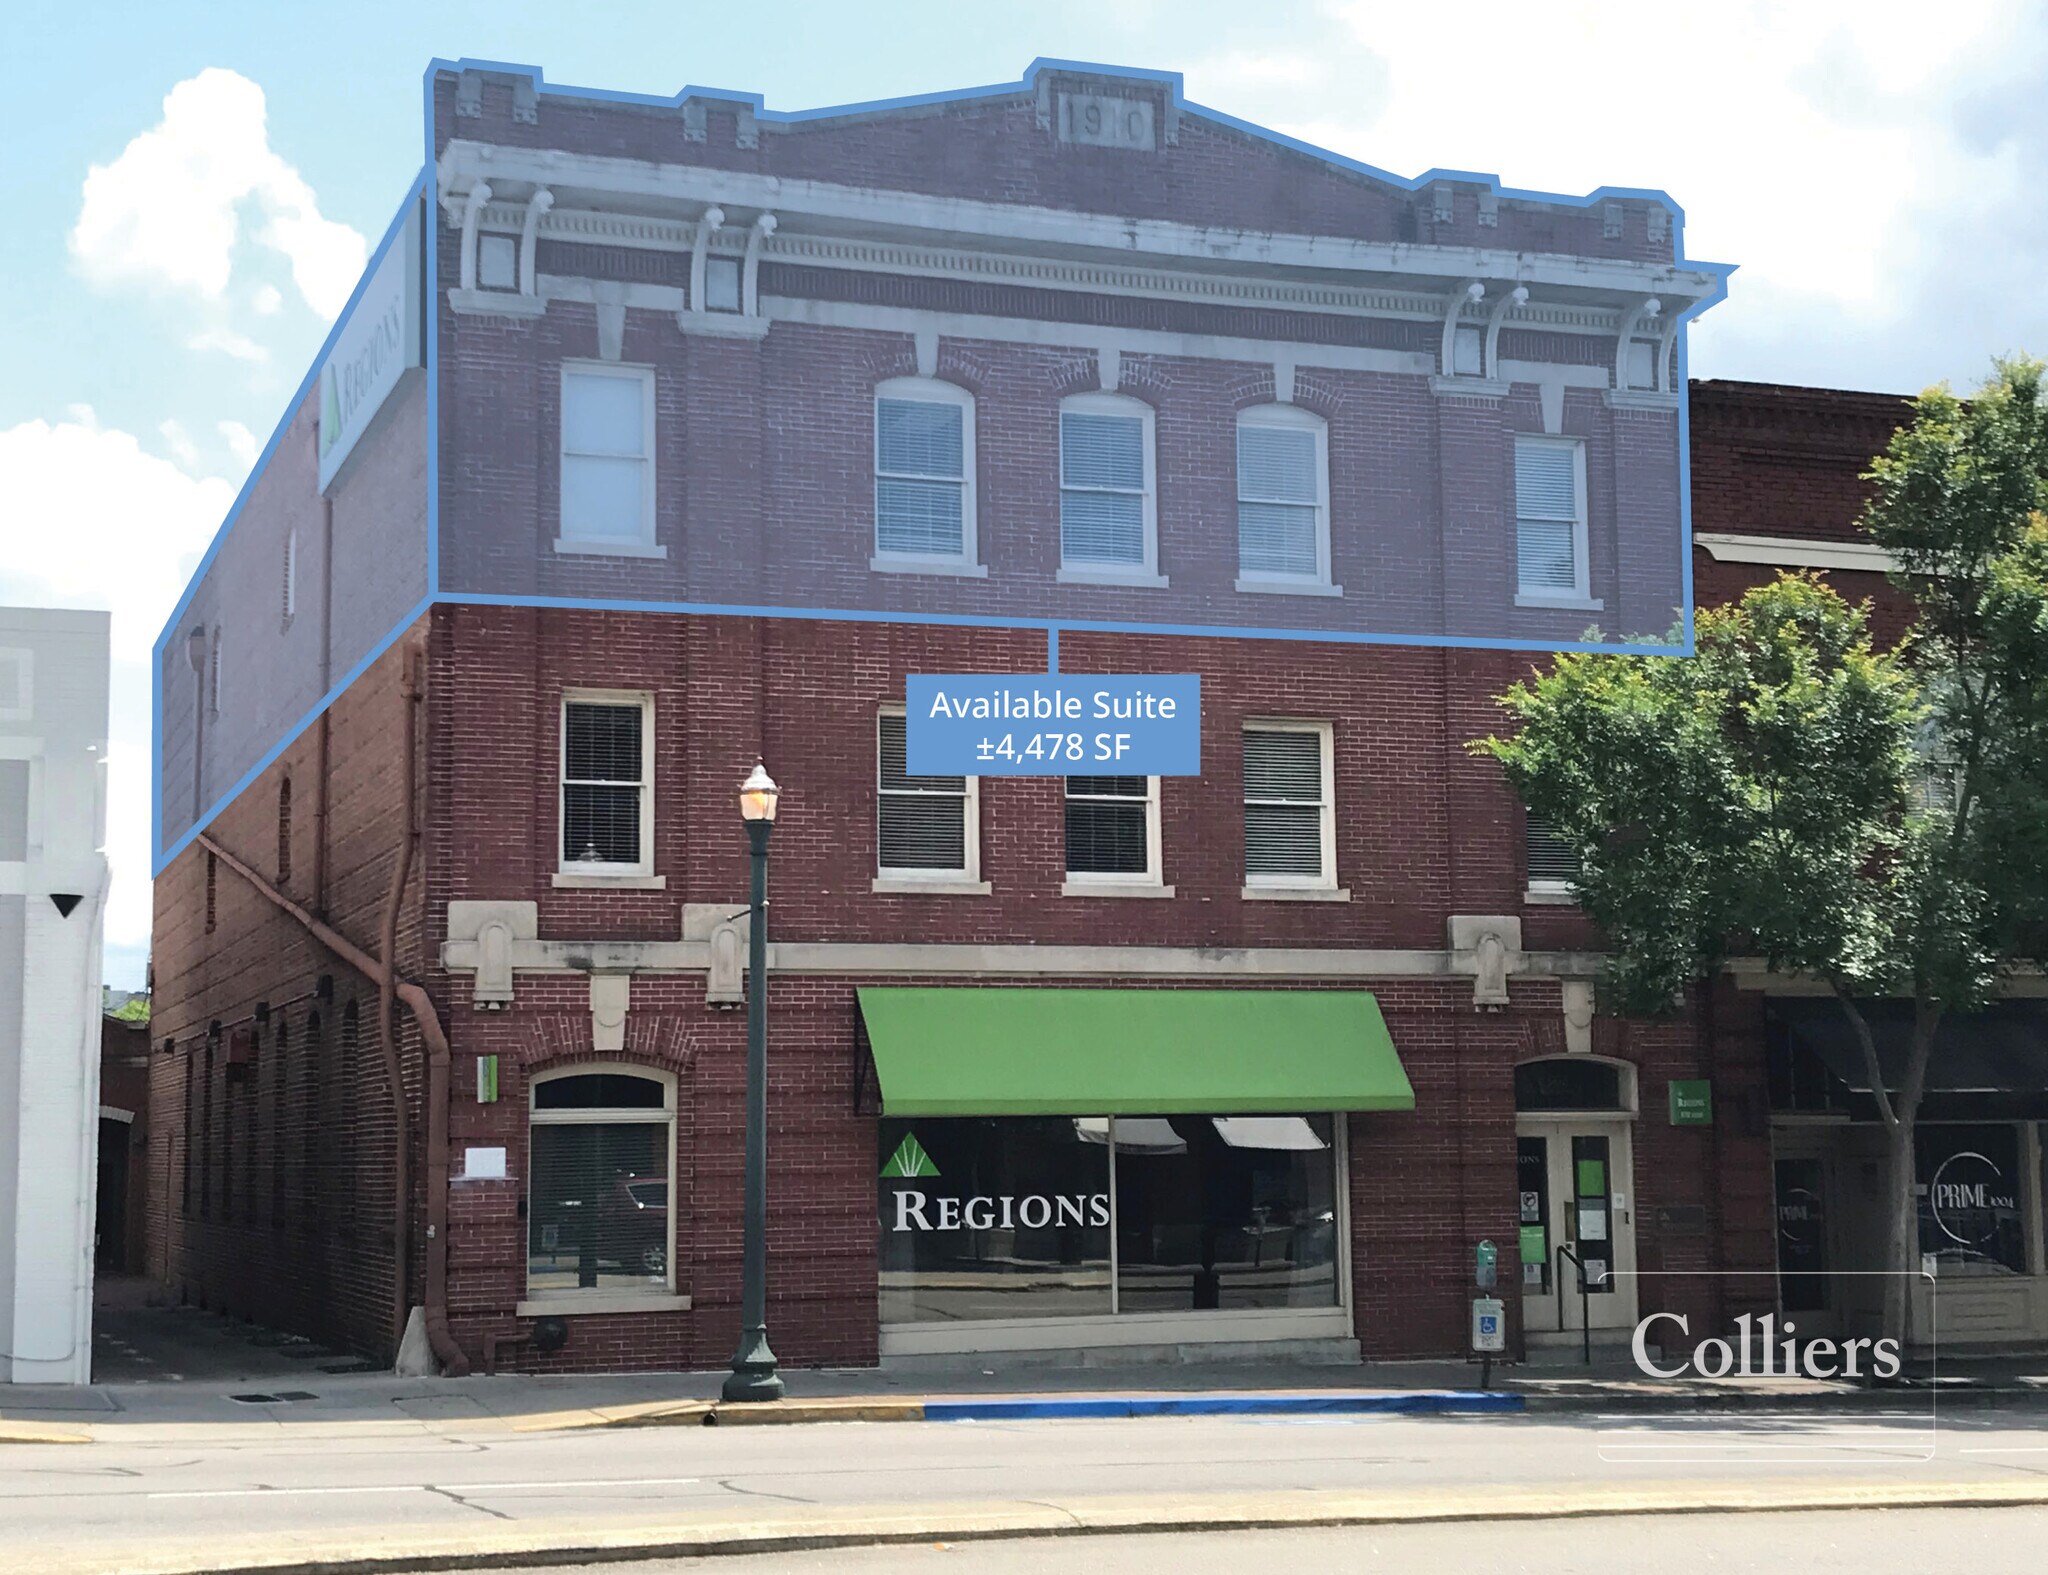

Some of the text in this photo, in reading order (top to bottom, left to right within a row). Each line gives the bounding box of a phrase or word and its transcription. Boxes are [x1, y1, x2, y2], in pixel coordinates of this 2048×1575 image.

[1066, 102, 1145, 142] 1910
[892, 1190, 1110, 1232] REGIONS
[1937, 1183, 1990, 1208] PRIME
